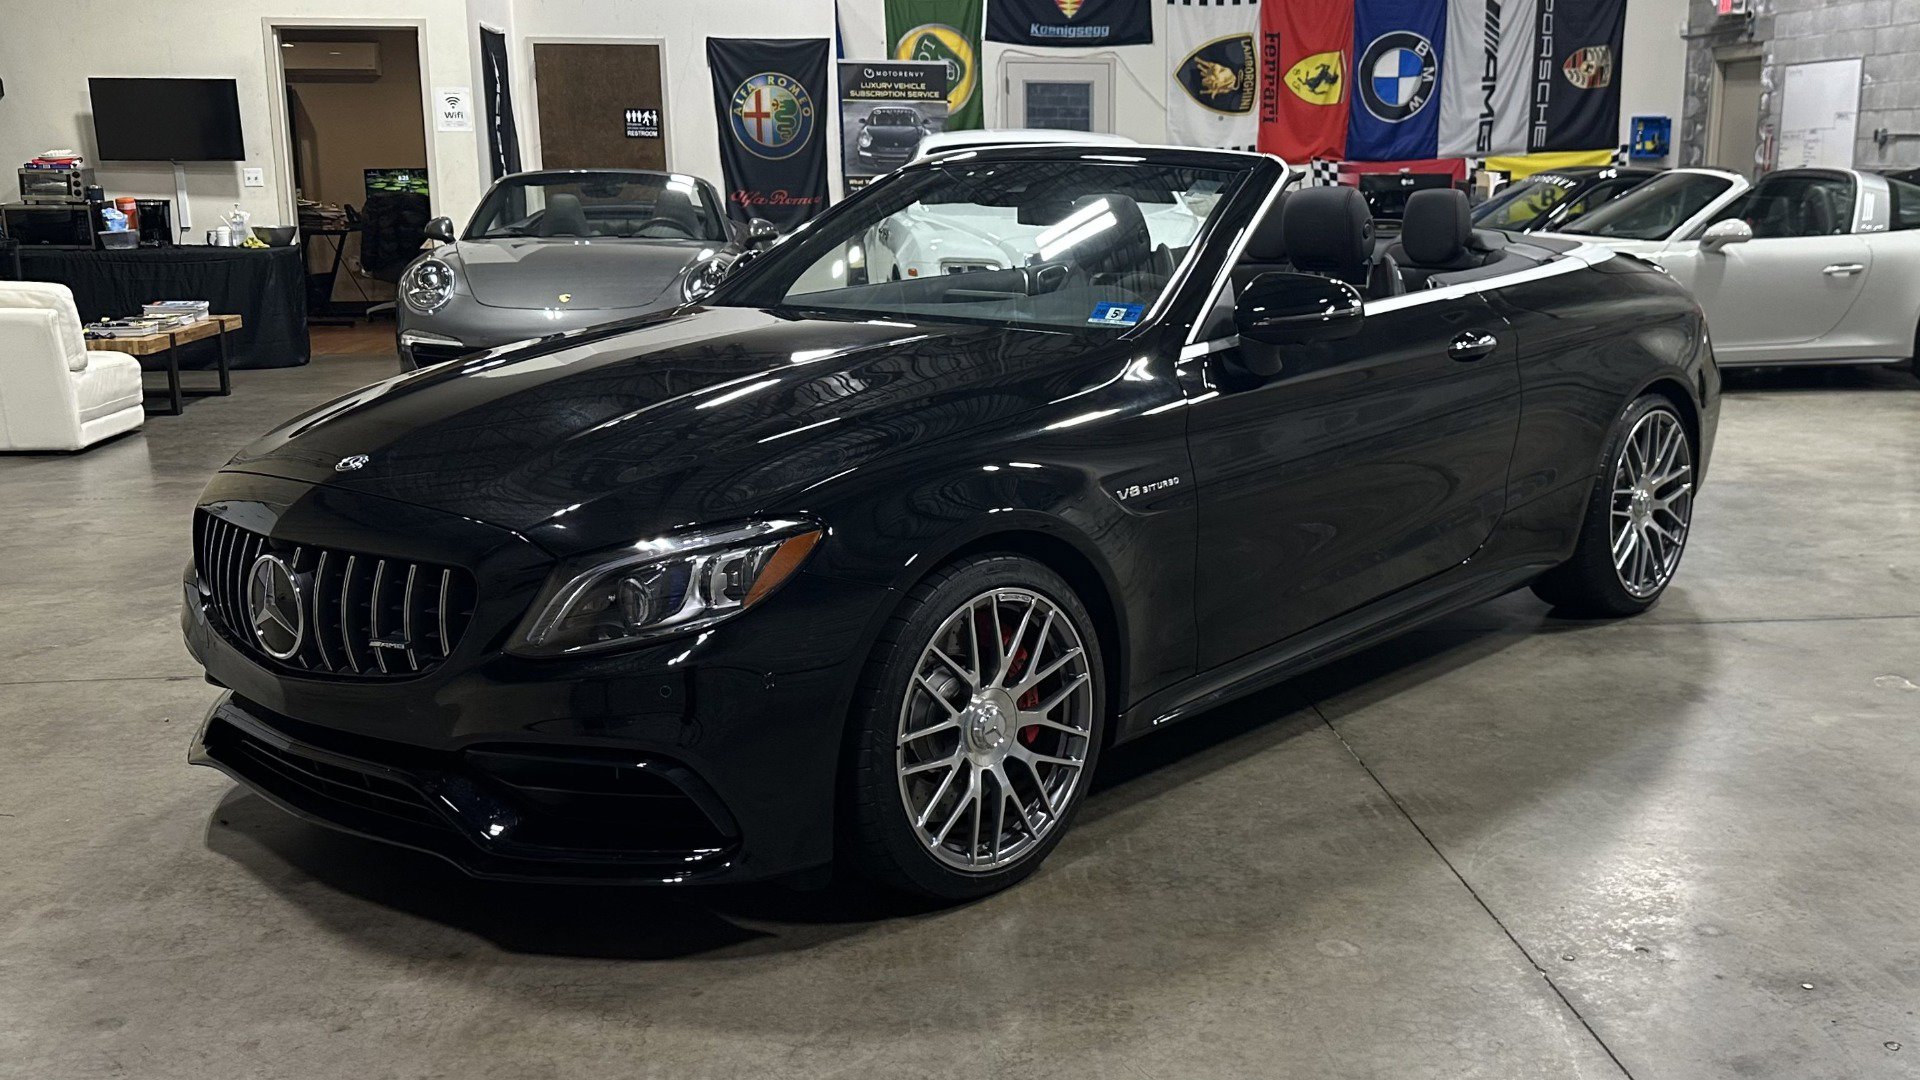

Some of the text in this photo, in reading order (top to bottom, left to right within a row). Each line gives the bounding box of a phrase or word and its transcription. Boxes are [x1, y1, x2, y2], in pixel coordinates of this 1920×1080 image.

[1030, 22, 1110, 38] Koenigsegg
[875, 70, 925, 78] MOTORENVY
[1239, 39, 1255, 111] LAMBORGHINI
[1263, 31, 1281, 124] Ferrari
[1409, 40, 1435, 112] BMW
[849, 89, 941, 99] SUBSCRIPTION SERVICE
[860, 81, 927, 90] LUXURY VEHICLE
[733, 75, 812, 118] ALFA ROMEO
[444, 111, 464, 119] Wifi
[626, 130, 658, 138] RESTROOM
[730, 189, 768, 208] Alfa
[1116, 476, 1180, 500] V8 BITURBO
